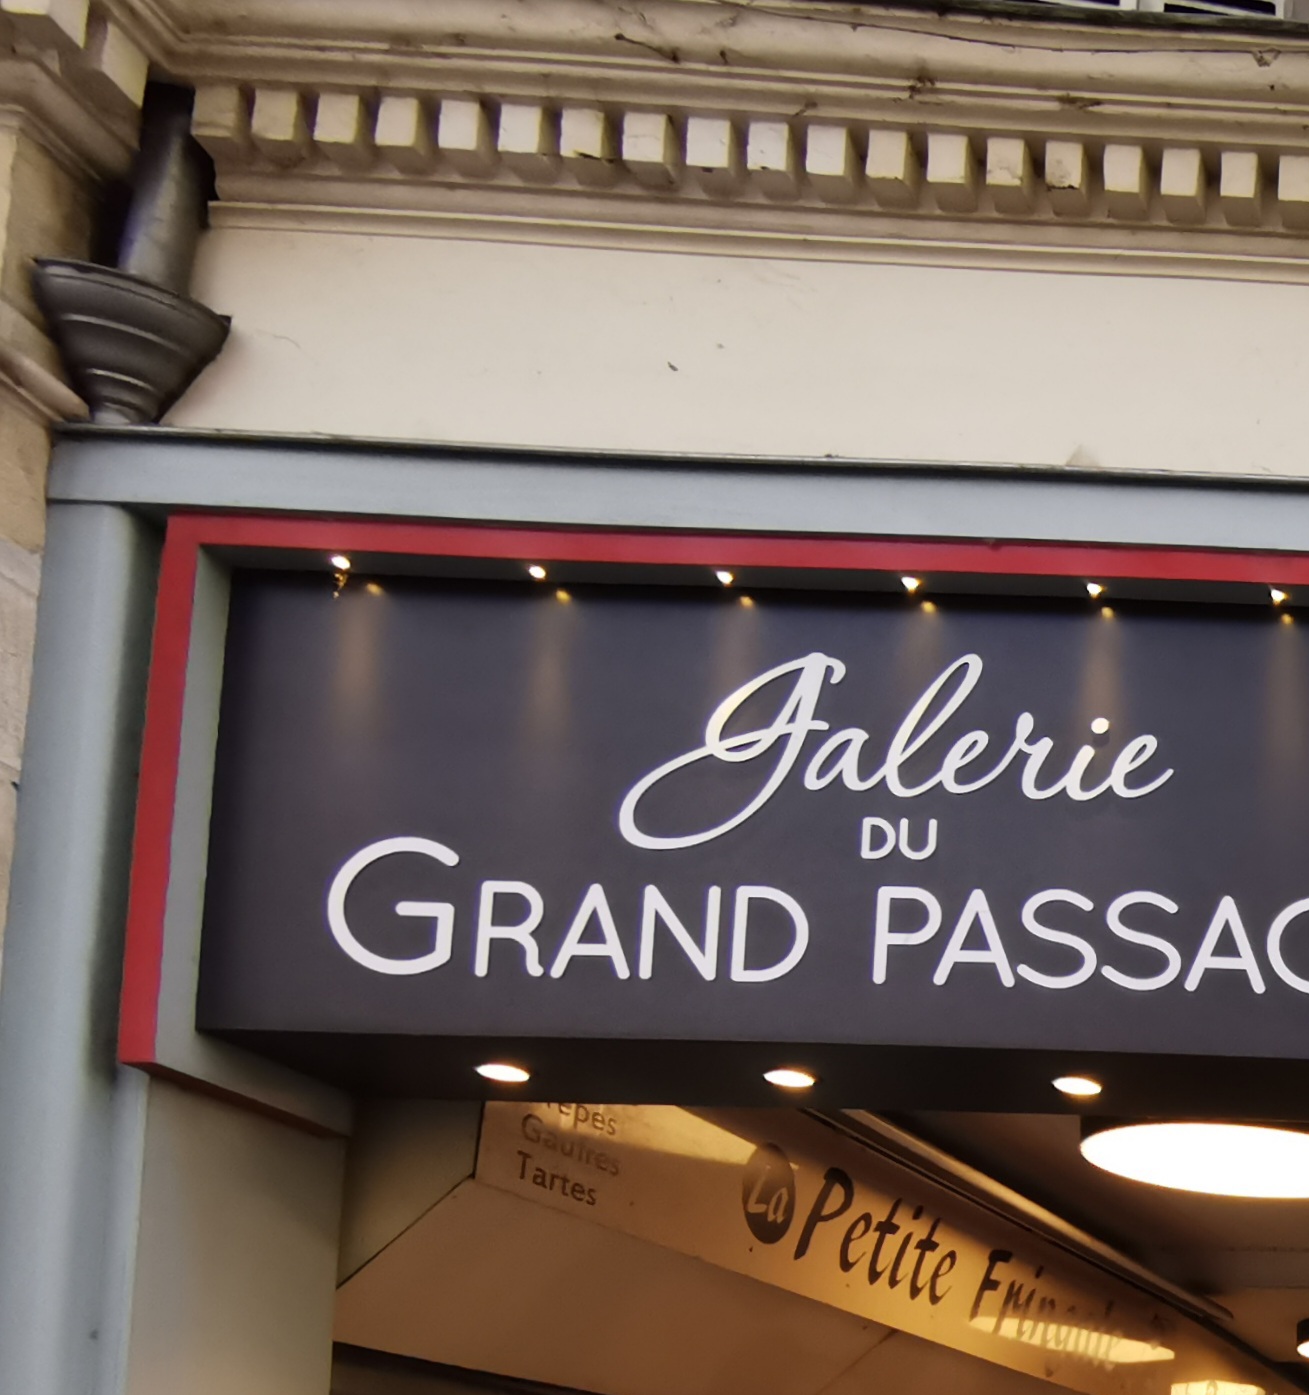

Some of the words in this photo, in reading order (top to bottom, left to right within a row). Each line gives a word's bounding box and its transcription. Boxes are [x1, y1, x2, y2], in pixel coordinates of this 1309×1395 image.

[619, 650, 1175, 850] Galerie
[327, 837, 809, 977] GRAND
[861, 816, 938, 860] DU
[516, 1150, 597, 1207] Tartes
[748, 1165, 789, 1224] La
[793, 1167, 958, 1307] Petite
